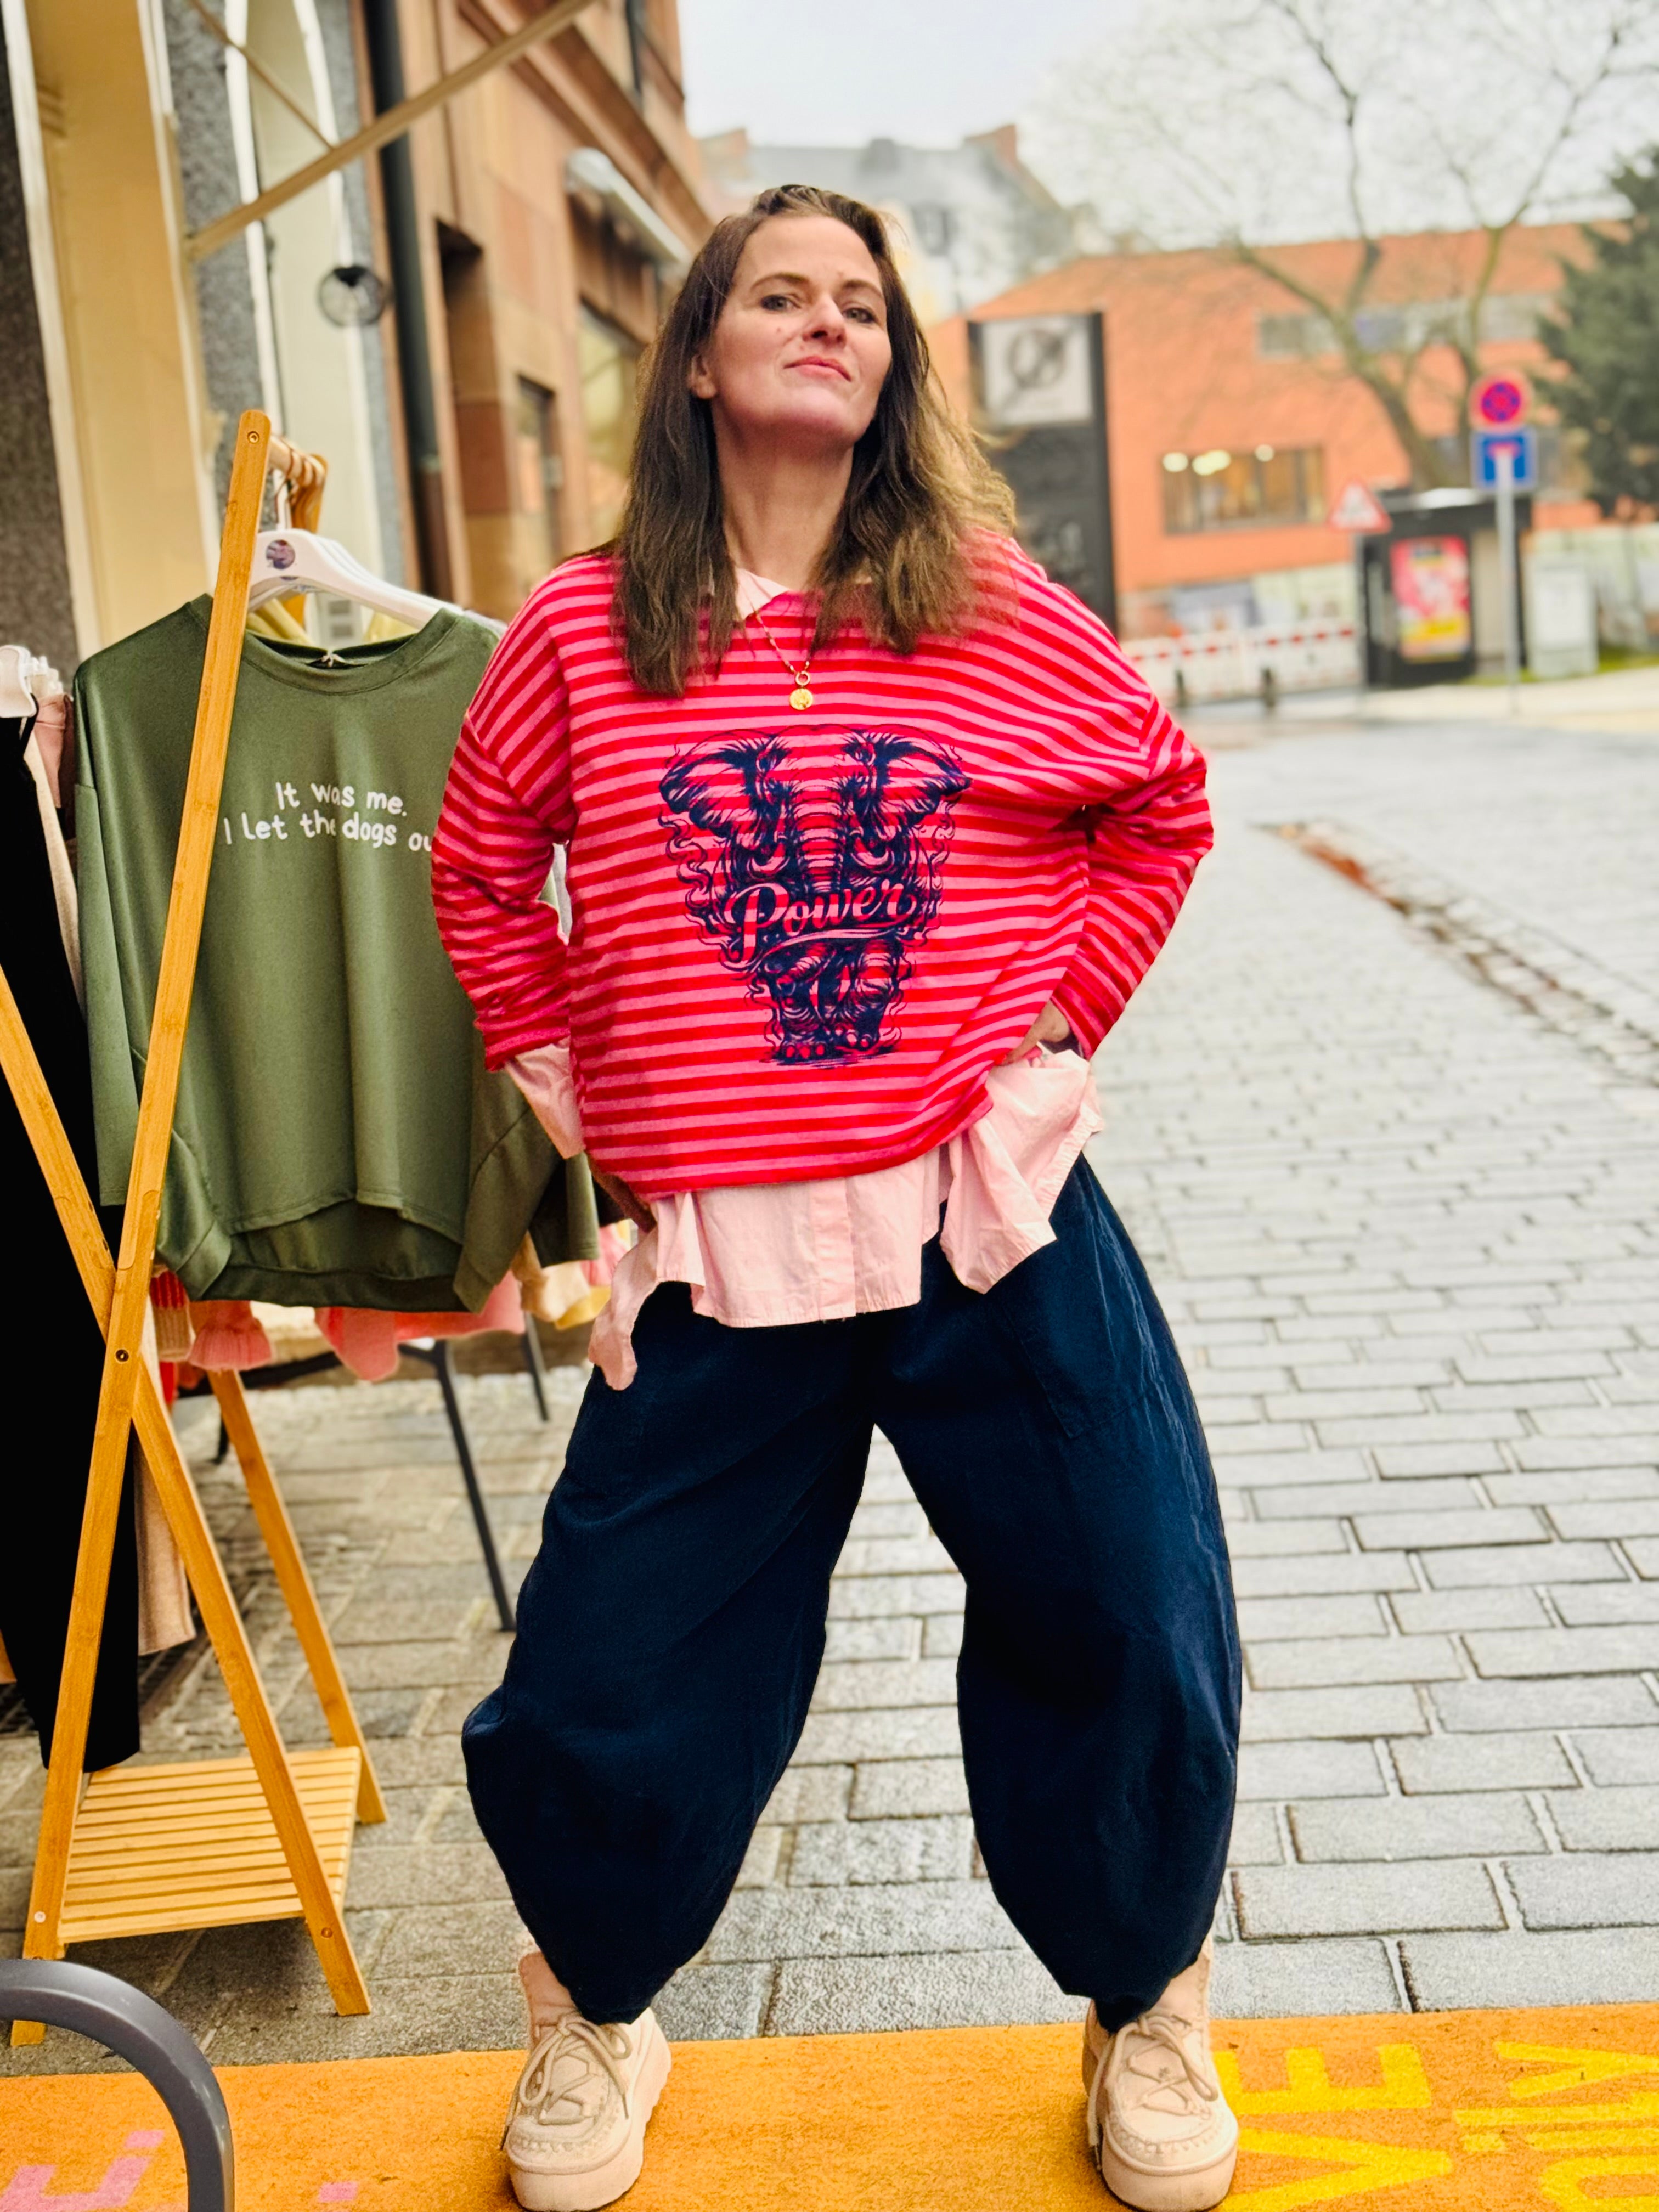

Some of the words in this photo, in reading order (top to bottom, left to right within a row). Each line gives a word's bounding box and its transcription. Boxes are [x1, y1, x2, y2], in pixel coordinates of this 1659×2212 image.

[275, 781, 301, 810] It
[311, 782, 355, 808] was
[366, 791, 408, 817] me.
[223, 817, 233, 845] I
[299, 809, 336, 838] the
[342, 811, 397, 849] dogs
[718, 879, 917, 969] Power
